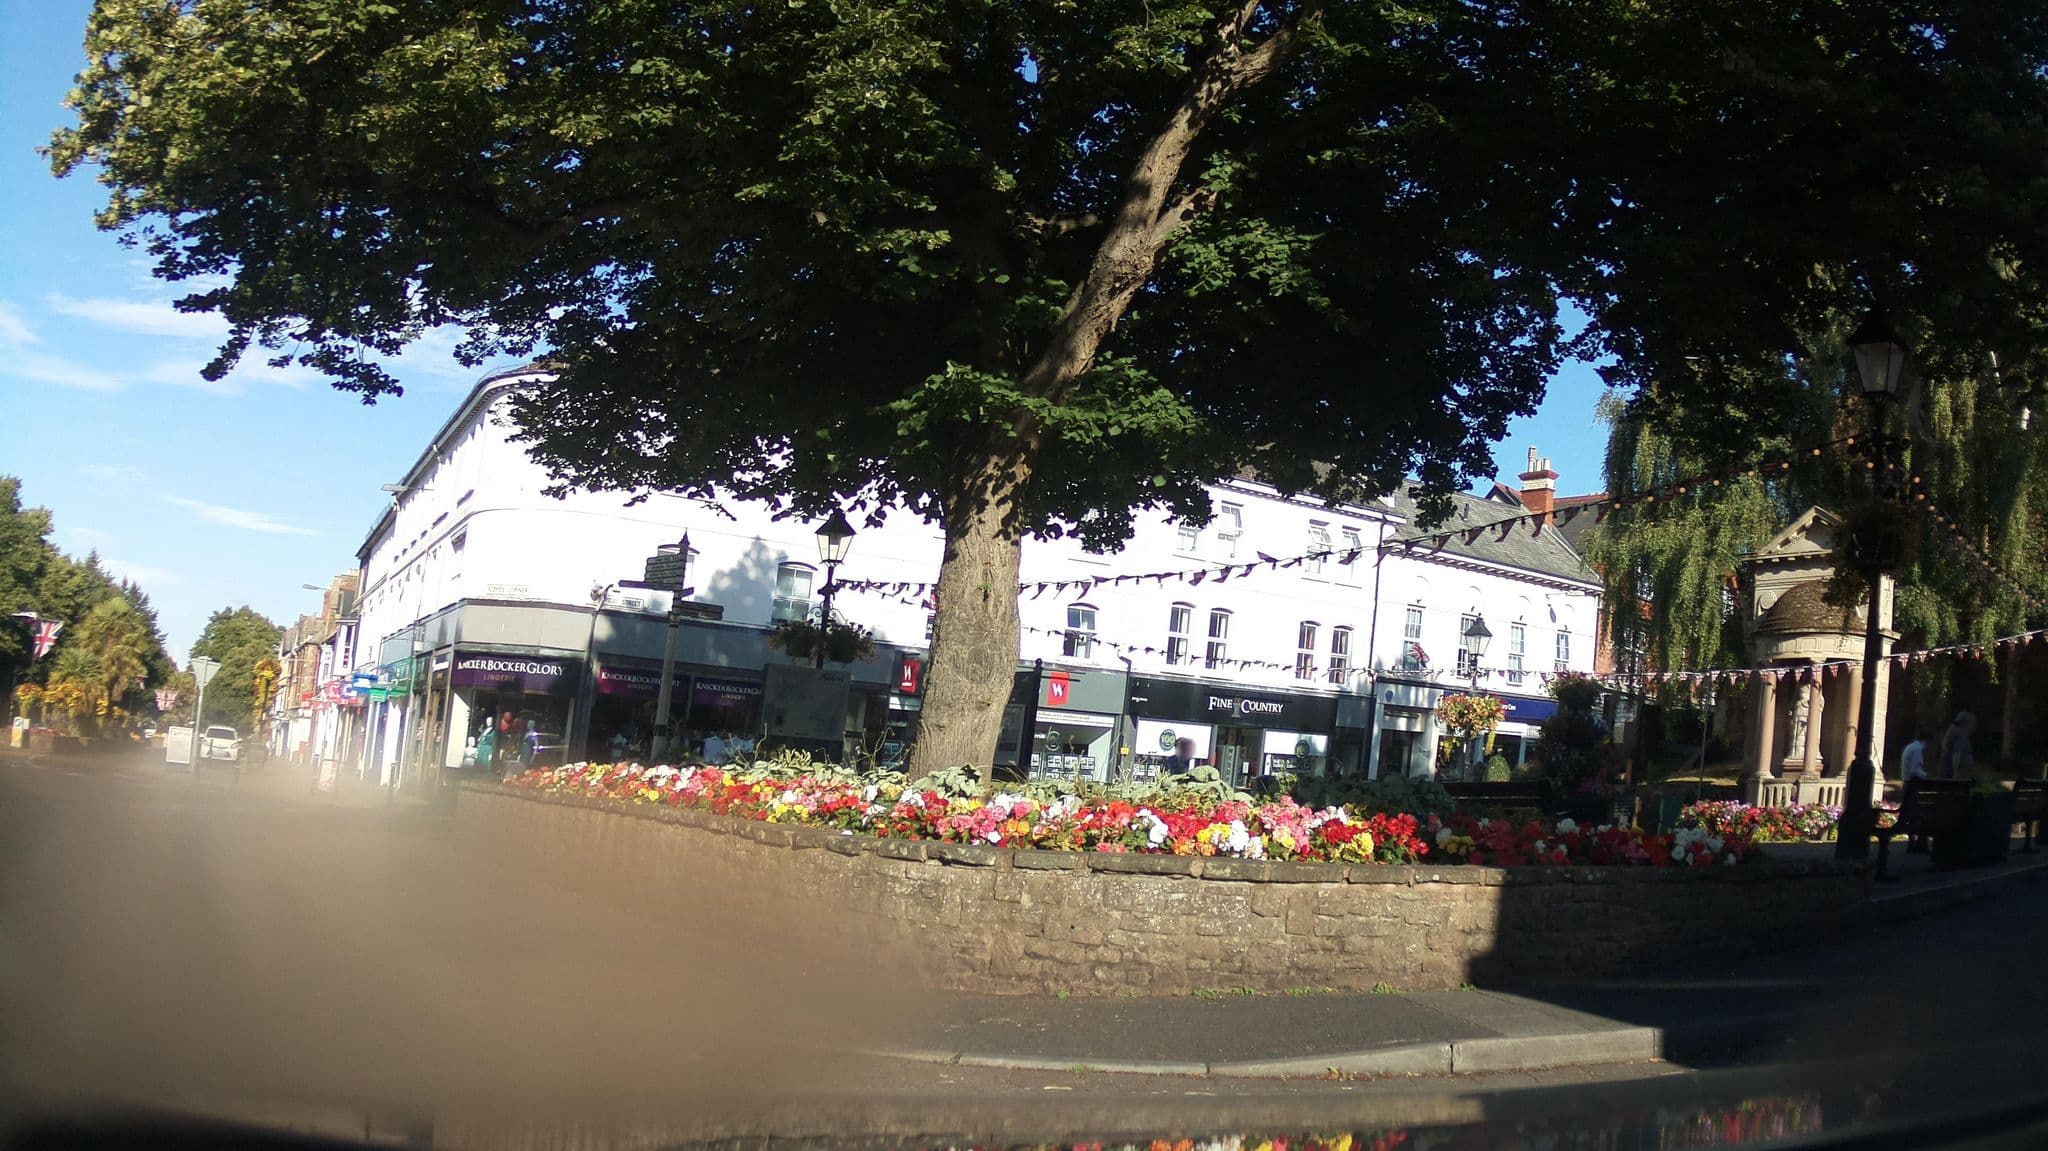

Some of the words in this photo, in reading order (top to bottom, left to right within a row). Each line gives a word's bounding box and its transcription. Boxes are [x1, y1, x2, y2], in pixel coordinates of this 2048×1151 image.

[1051, 683, 1066, 697] W
[1207, 696, 1233, 711] FINE
[1240, 699, 1284, 714] COUNTRY
